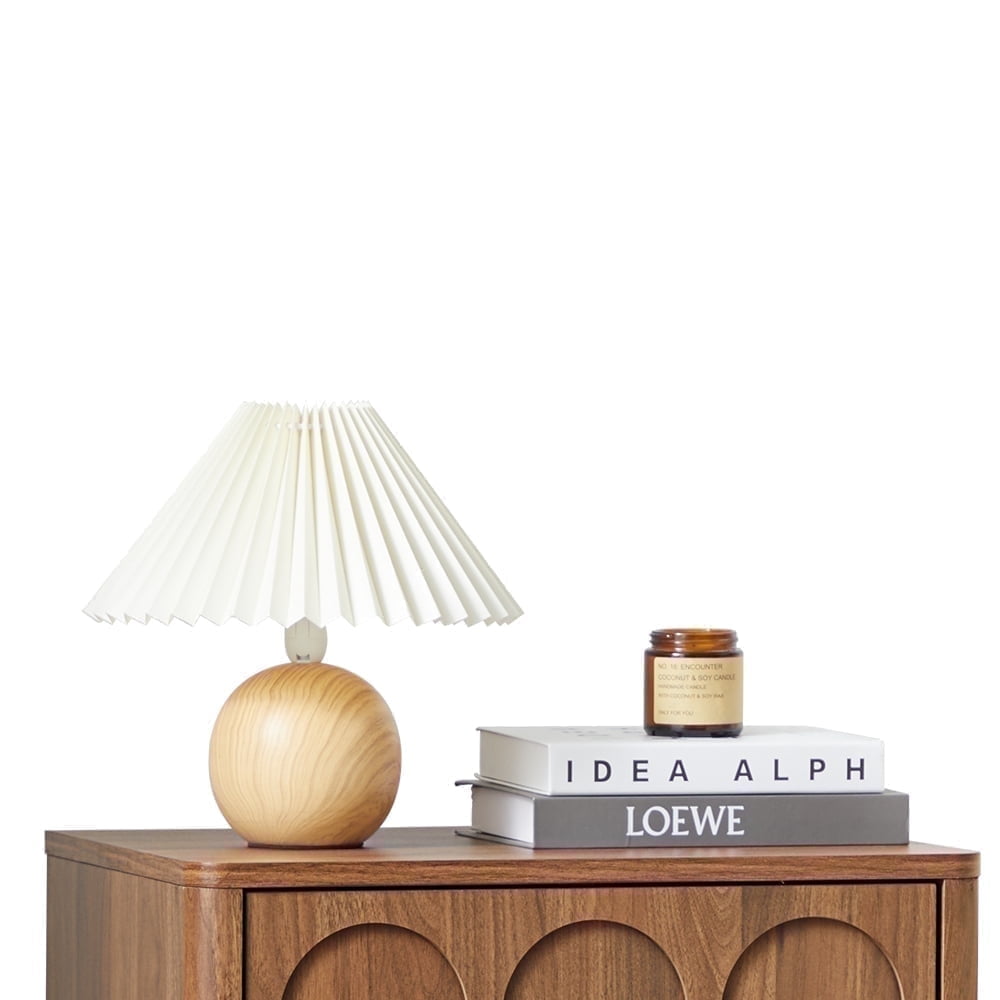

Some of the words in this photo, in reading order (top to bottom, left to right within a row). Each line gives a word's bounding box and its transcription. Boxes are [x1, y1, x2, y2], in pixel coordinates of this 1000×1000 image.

[714, 673, 736, 681] CANDLE
[567, 759, 689, 783] IDEA
[733, 758, 865, 782] ALPH
[626, 805, 745, 837] LOEWE
